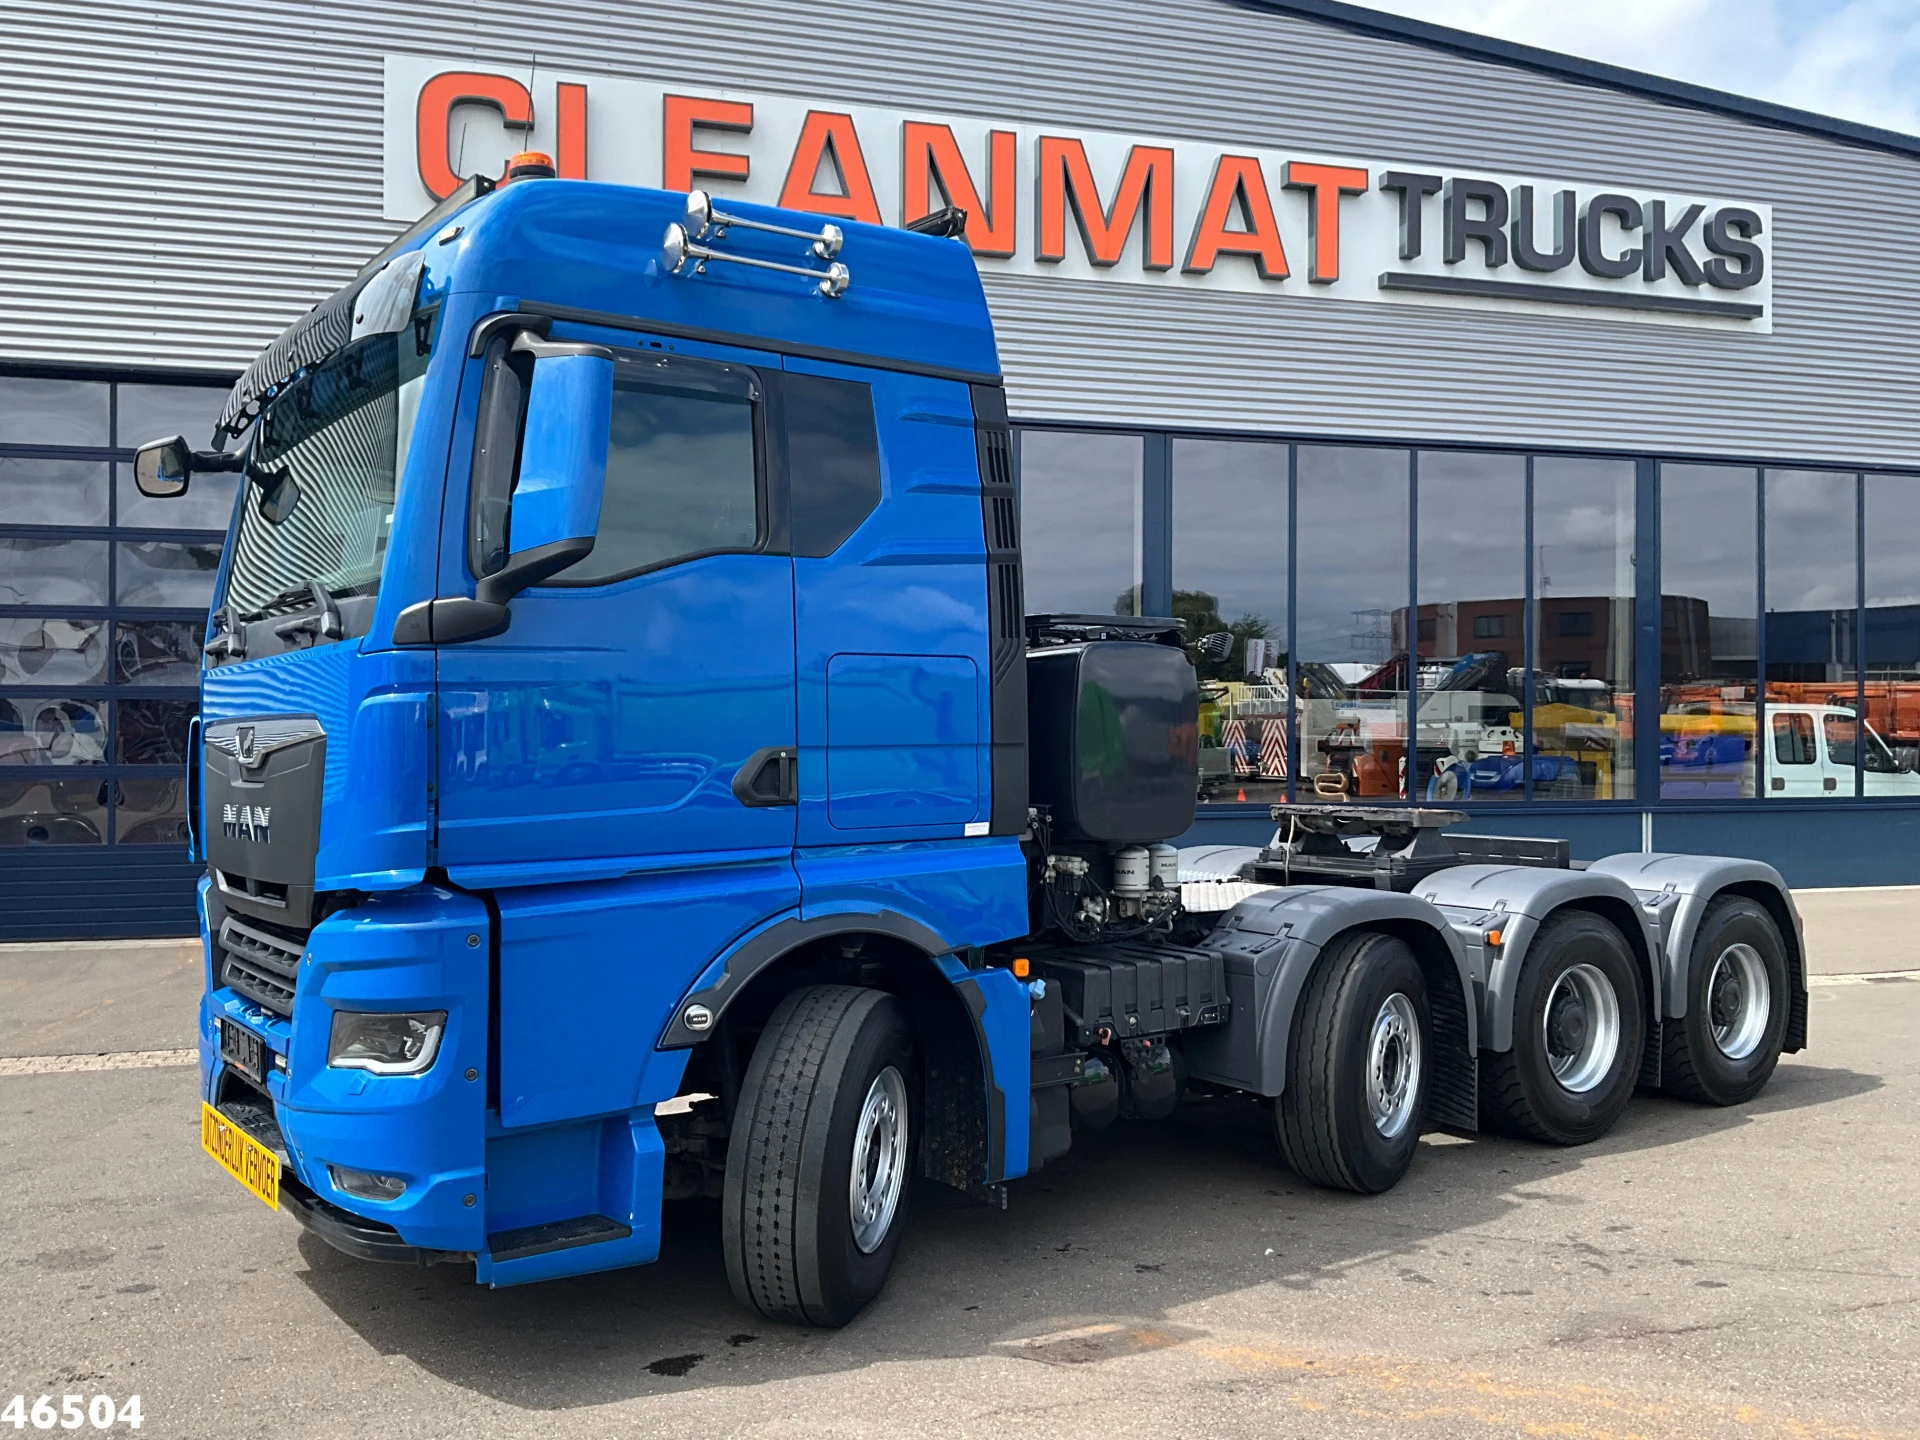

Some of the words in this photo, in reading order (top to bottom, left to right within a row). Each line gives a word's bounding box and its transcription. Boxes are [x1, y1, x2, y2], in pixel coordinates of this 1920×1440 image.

[1379, 171, 1763, 290] TRUCKS
[223, 804, 271, 844] MAN
[246, 1142, 276, 1203] VERVOER
